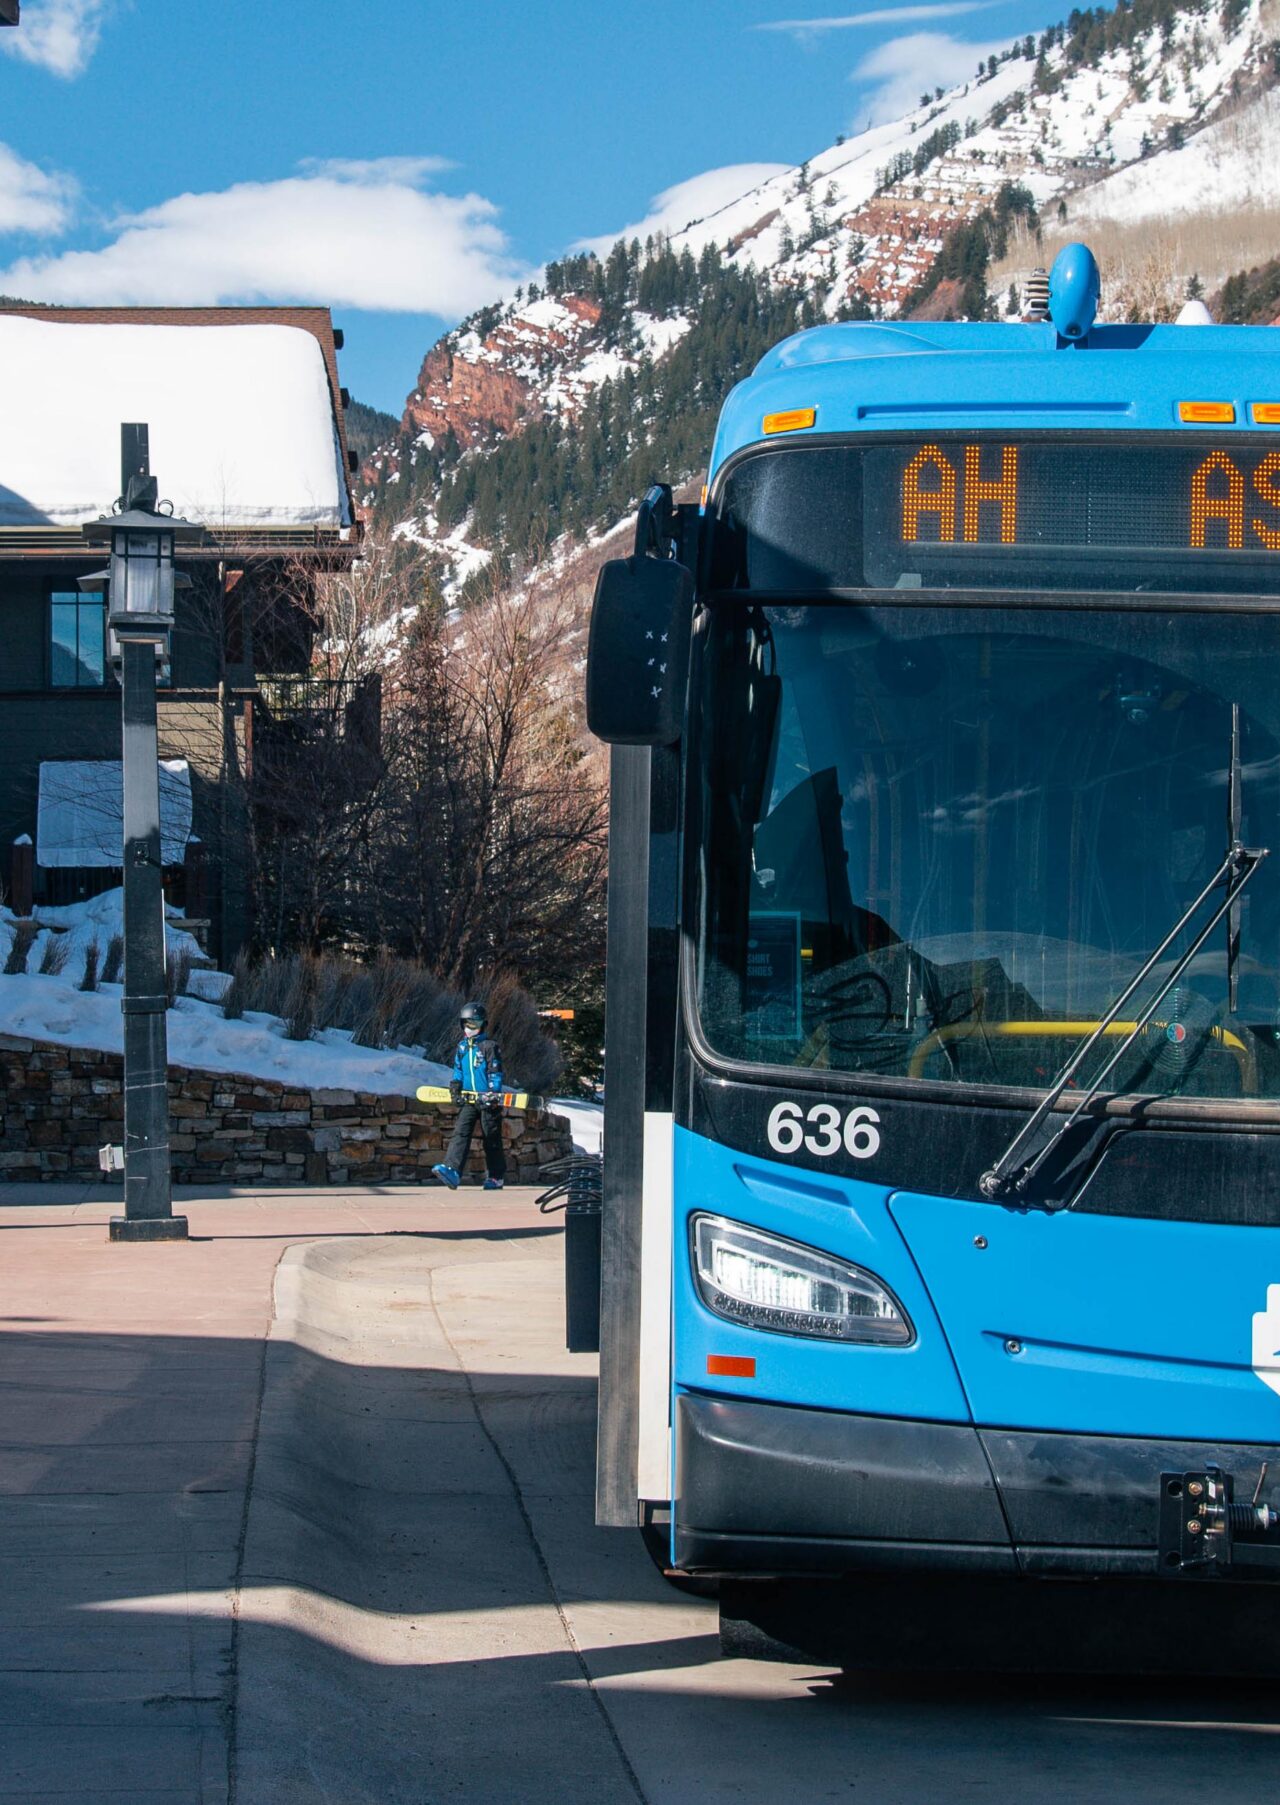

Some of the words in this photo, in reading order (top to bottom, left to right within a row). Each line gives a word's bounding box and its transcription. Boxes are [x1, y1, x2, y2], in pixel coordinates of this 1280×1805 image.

[900, 444, 1018, 543] AH
[747, 953, 770, 964] SHIRT
[747, 965, 773, 977] SHOES
[767, 1100, 881, 1159] 636
